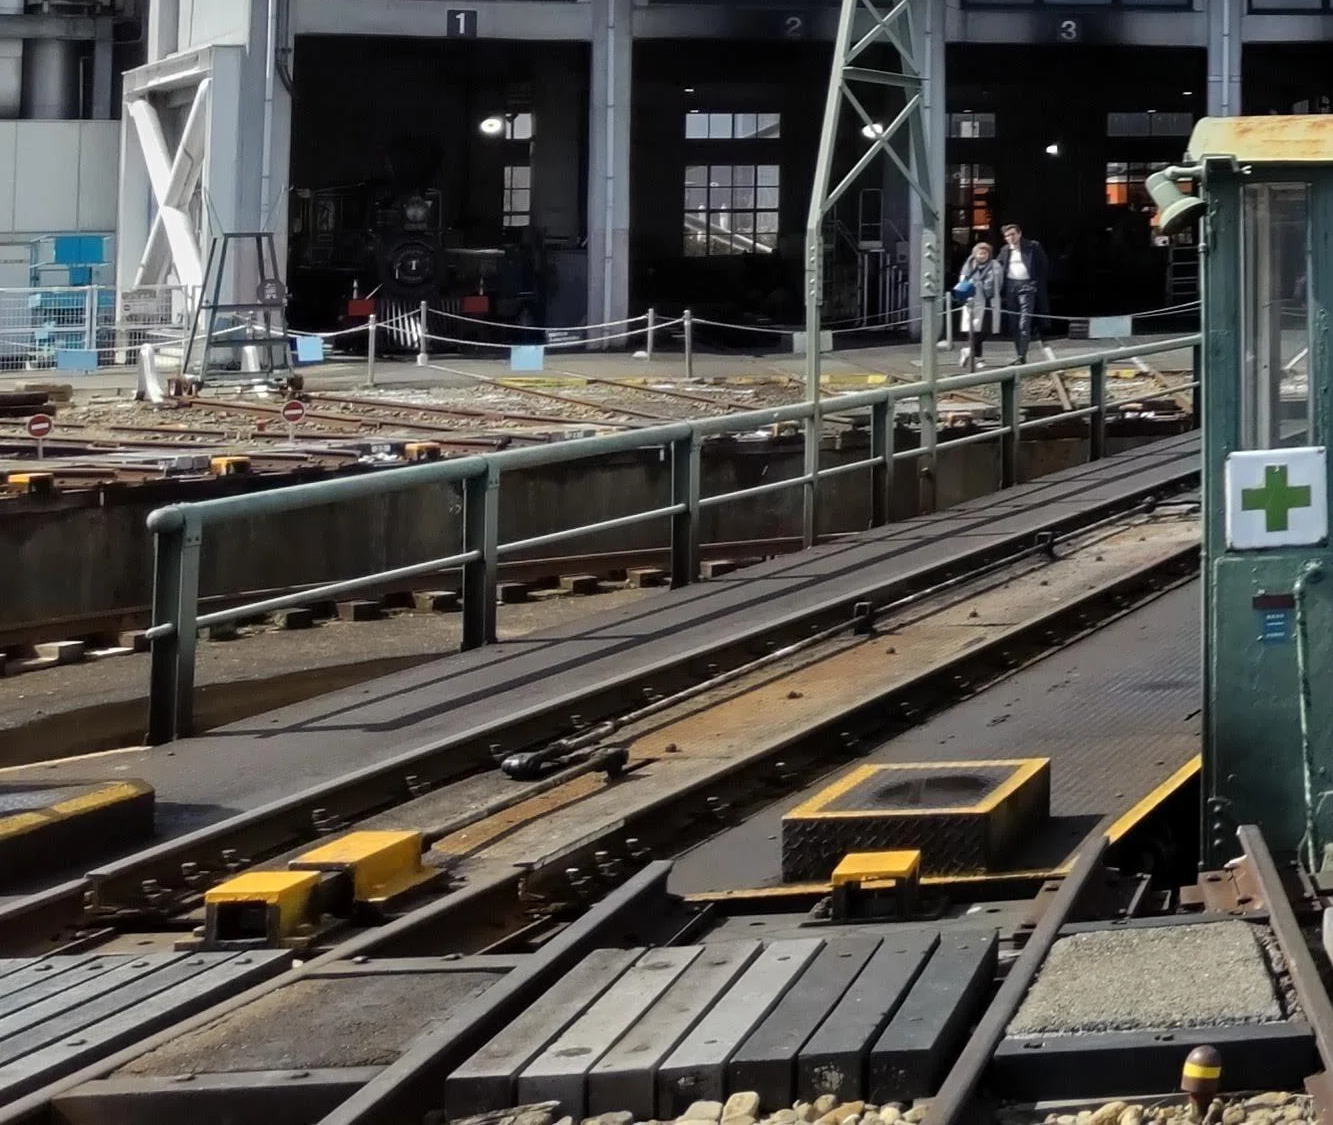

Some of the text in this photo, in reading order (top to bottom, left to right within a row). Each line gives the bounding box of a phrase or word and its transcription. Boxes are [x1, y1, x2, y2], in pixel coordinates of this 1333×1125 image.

[455, 12, 466, 34] 1
[786, 16, 802, 37] 2
[1061, 20, 1077, 40] 3
